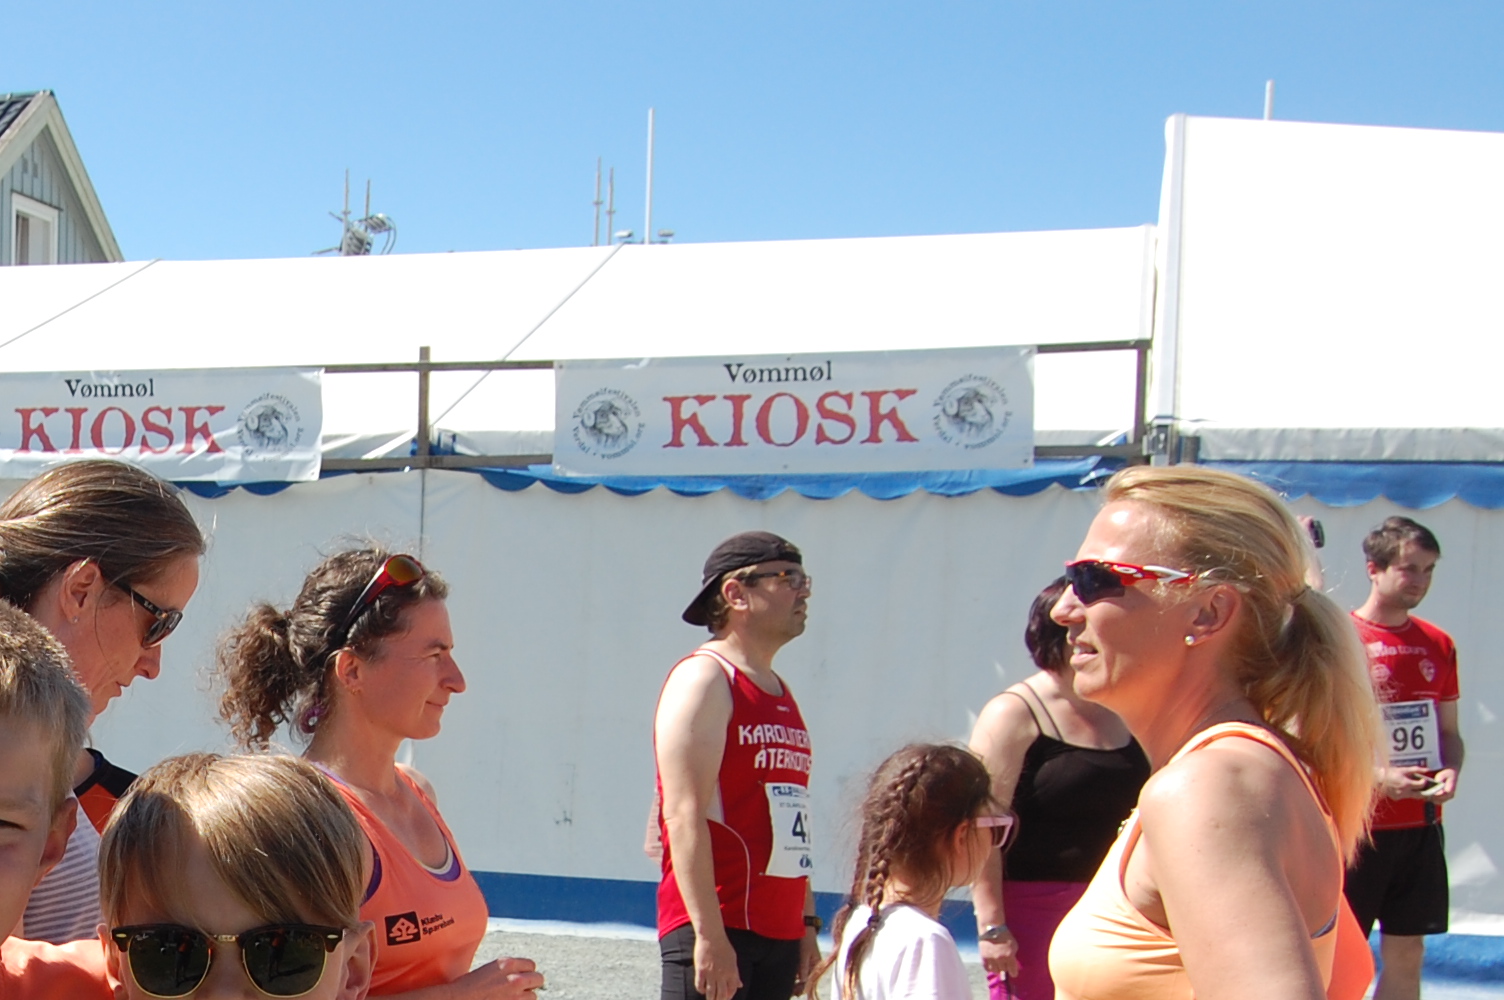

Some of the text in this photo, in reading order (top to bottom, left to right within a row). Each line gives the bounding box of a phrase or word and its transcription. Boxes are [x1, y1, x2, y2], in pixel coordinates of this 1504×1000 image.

[724, 360, 833, 383] Vømmøl
[65, 378, 154, 398] Vømmøl
[14, 404, 226, 456] KIOSK
[662, 388, 920, 449] KIOSK
[1392, 725, 1425, 752] 96
